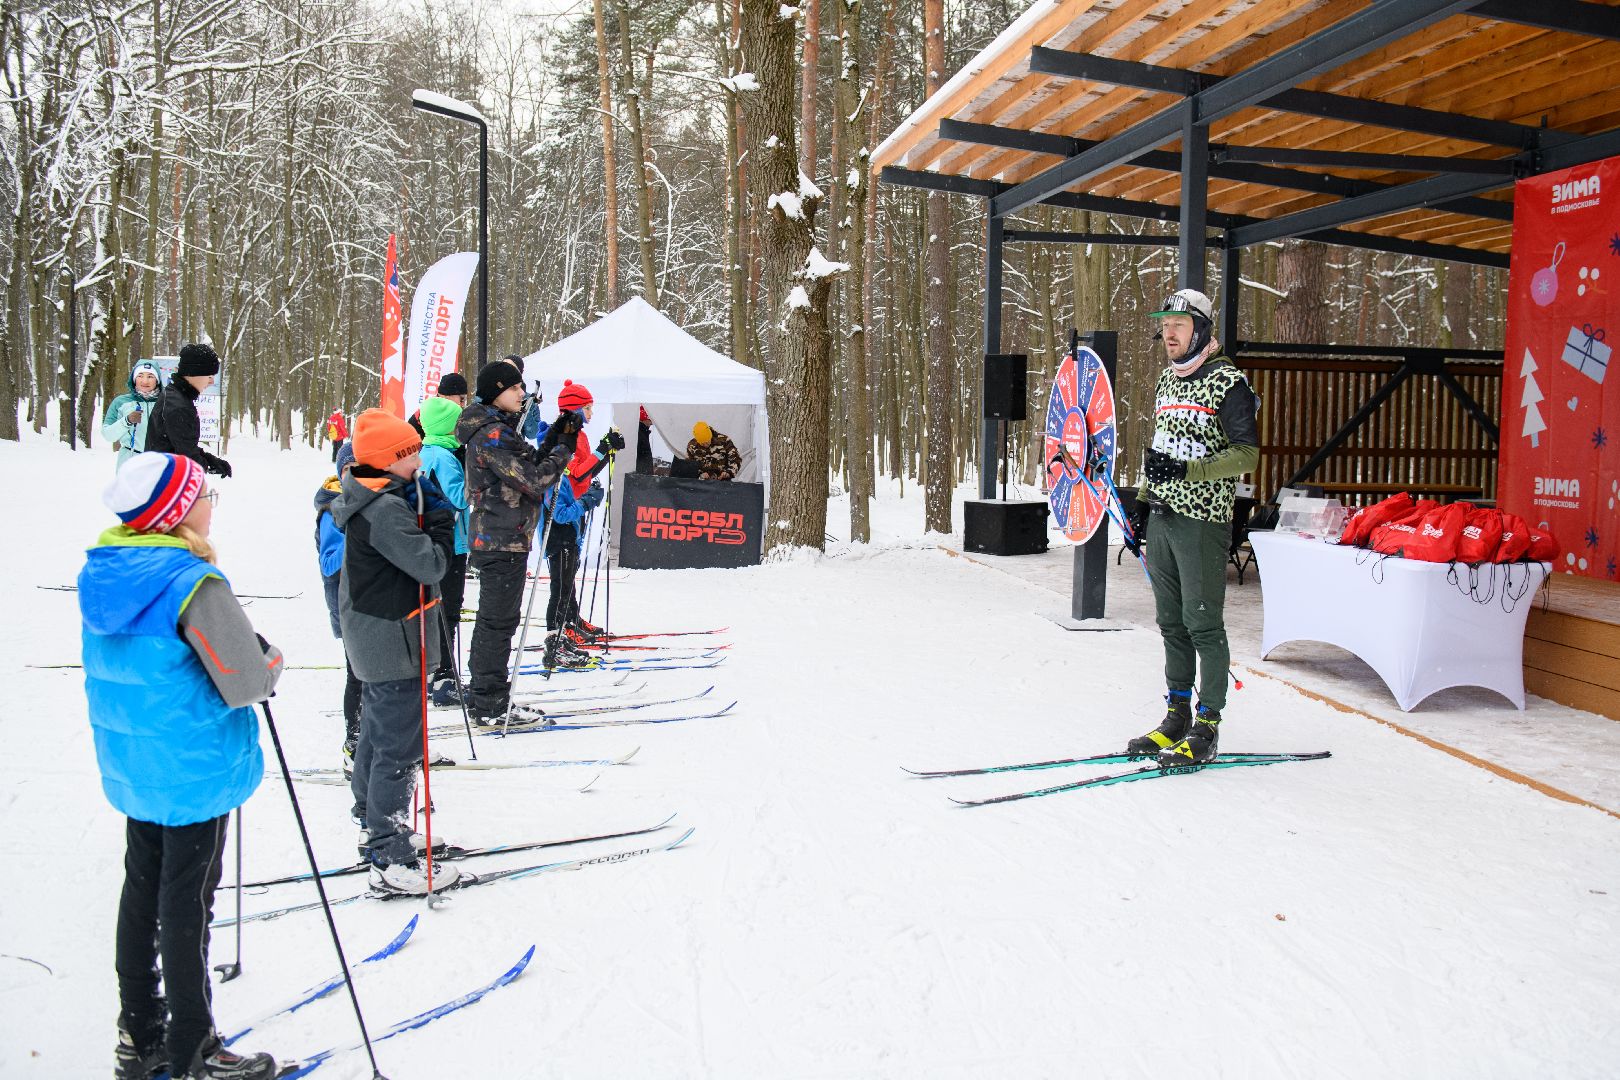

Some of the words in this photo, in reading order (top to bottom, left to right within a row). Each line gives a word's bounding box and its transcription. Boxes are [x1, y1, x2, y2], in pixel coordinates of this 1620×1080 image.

[1552, 175, 1601, 204] ЗИМА
[1556, 198, 1601, 213] ПОДМОСКОВЬЕ
[421, 292, 437, 346] КАЧЕСТВА
[395, 448, 407, 461] NO
[406, 441, 422, 455] DOU
[1534, 477, 1580, 498] ЗИМА
[1538, 499, 1580, 509] ПОДМОСКОВЬЕ
[636, 506, 744, 529] МОСОБЛ
[635, 523, 720, 543] СПОРТ
